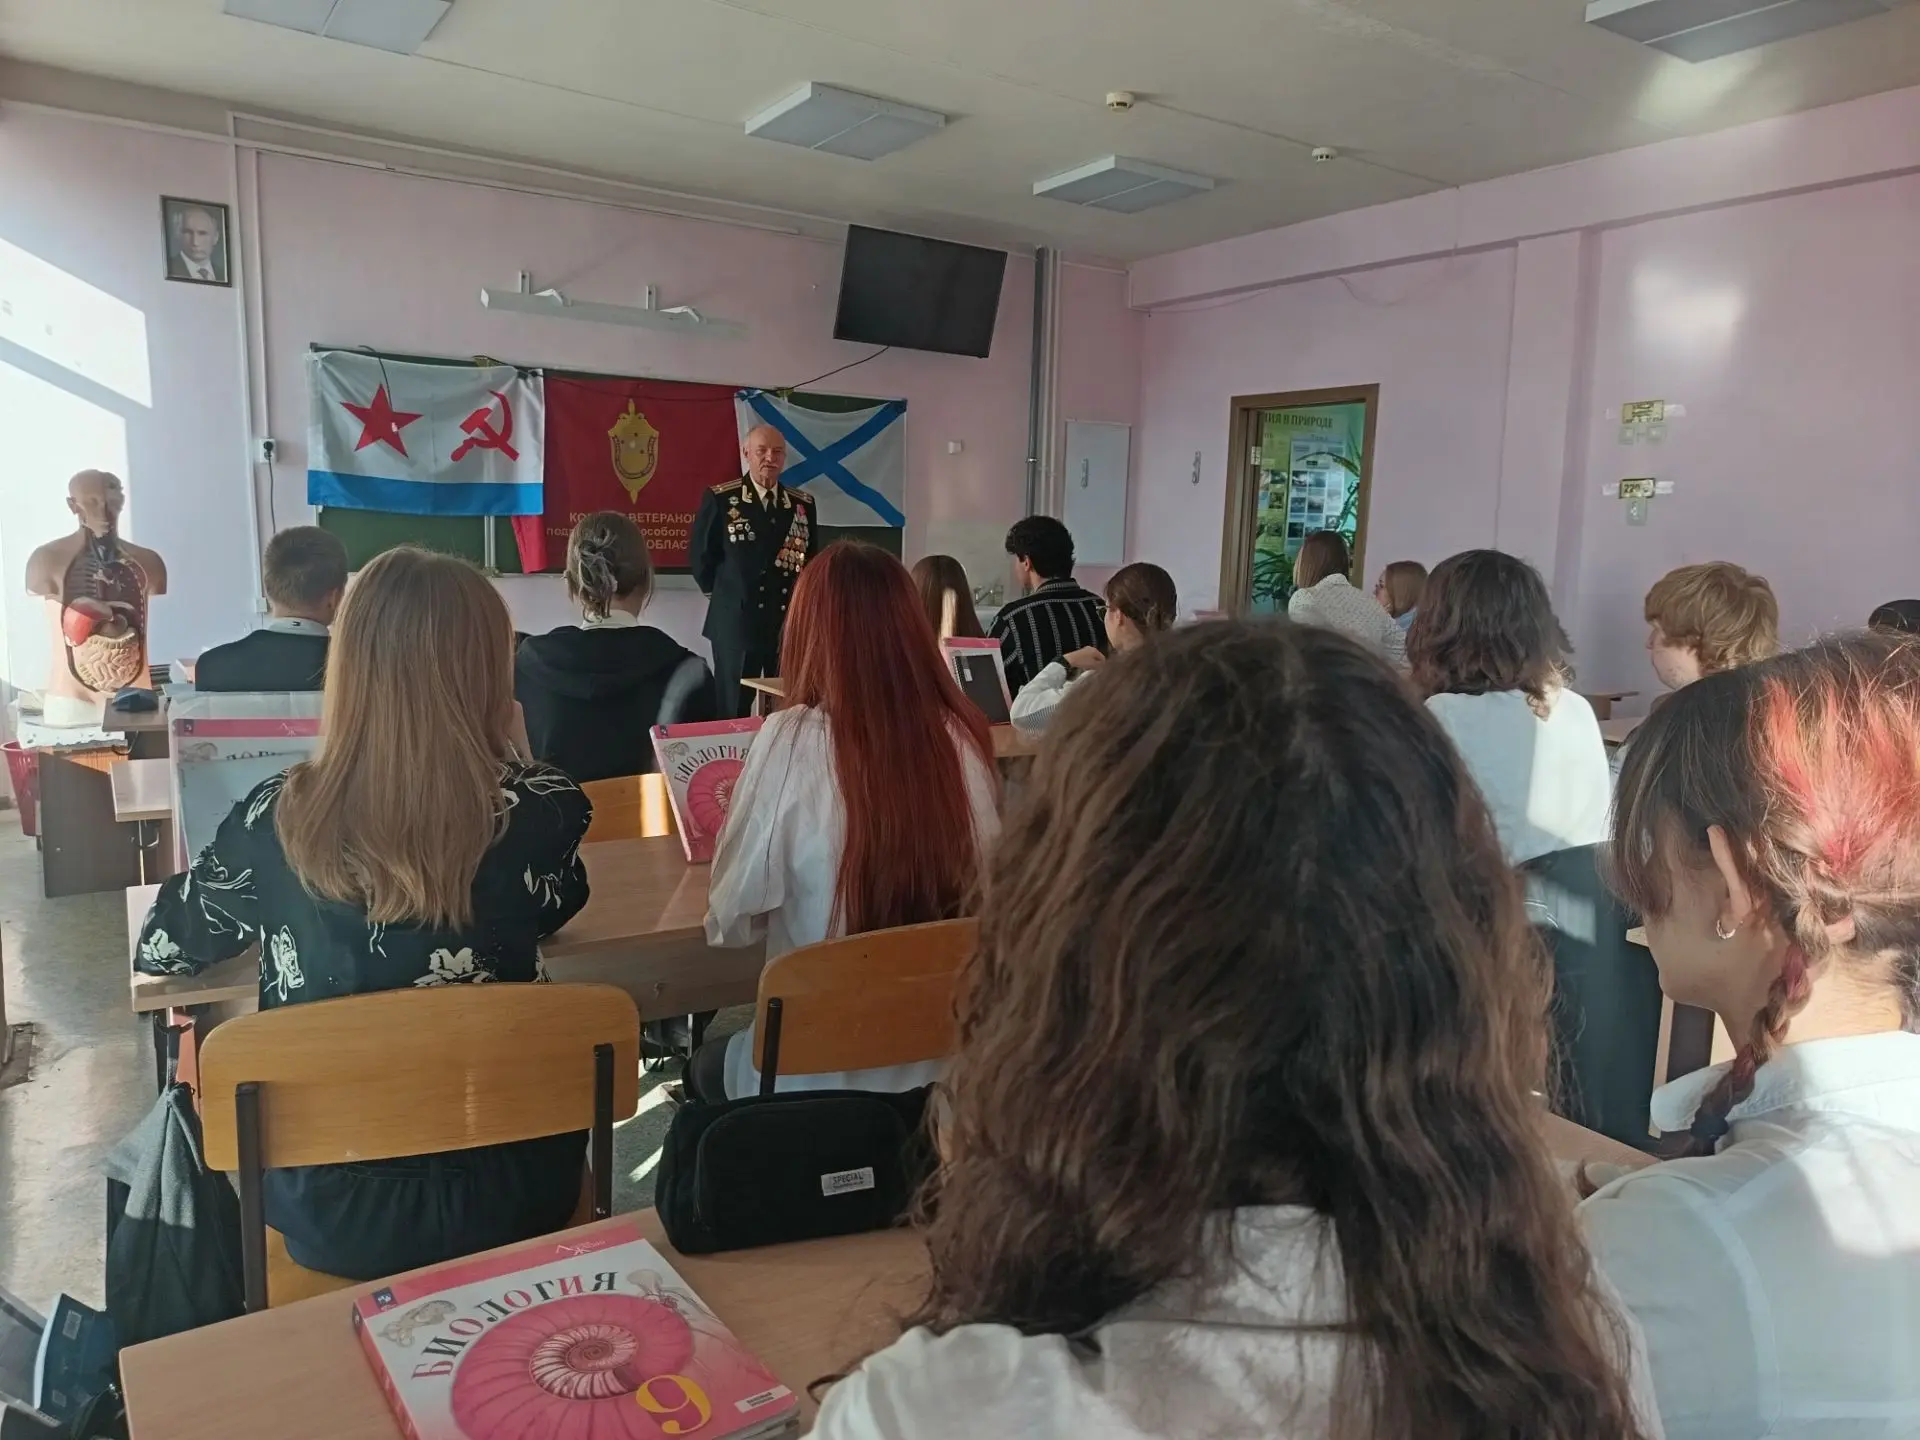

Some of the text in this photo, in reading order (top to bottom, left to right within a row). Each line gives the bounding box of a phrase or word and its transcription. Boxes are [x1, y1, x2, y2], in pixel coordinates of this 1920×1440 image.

[1291, 414, 1334, 430] ПРИРОДЕ
[628, 512, 696, 524] ВЕТЕРАНО
[640, 526, 687, 537] особого
[832, 1171, 864, 1185] SPECIAL
[411, 1271, 618, 1381] БИОЛОГИЯ
[635, 1374, 713, 1435] 9
